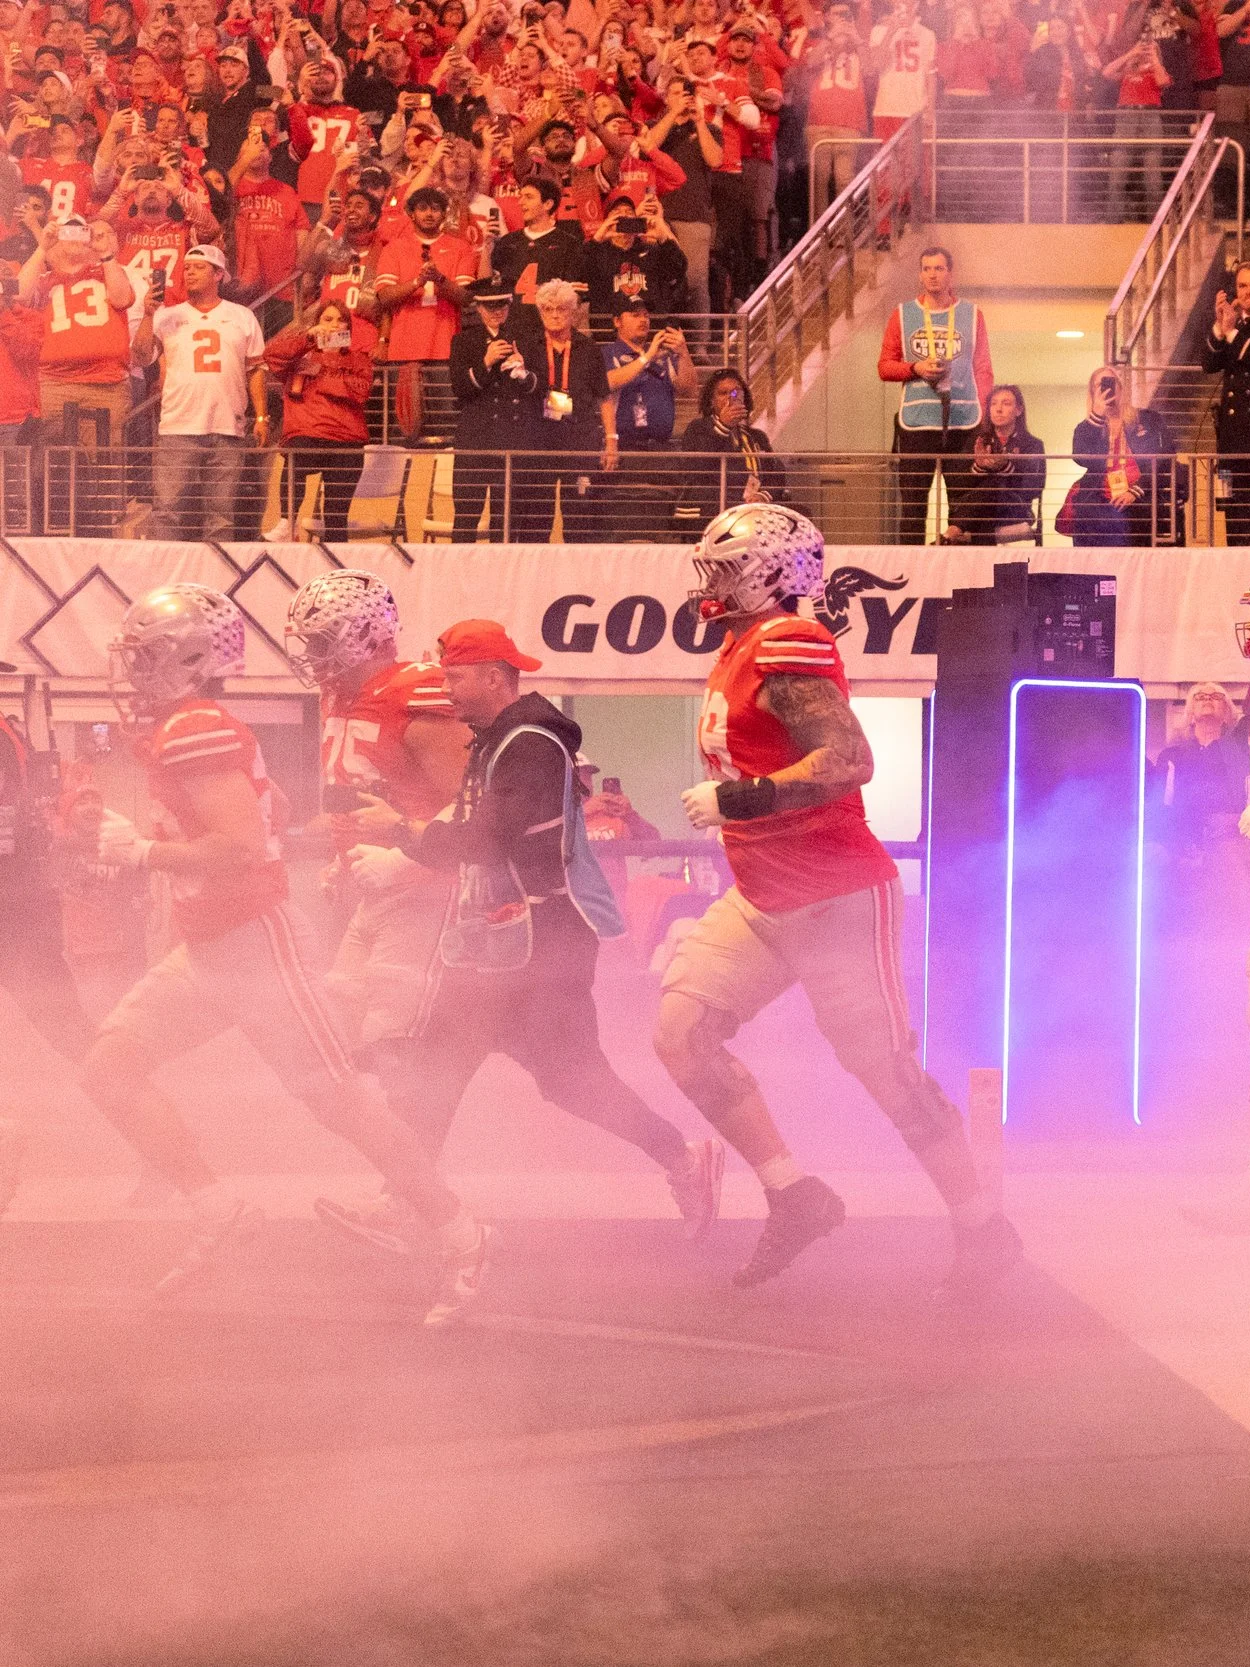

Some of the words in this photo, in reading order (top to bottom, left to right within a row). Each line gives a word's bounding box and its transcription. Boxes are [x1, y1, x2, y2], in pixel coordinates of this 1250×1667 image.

[895, 40, 919, 72] 15
[307, 115, 351, 153] 97
[149, 233, 182, 247] STATE
[124, 248, 179, 288] 47
[514, 263, 539, 304] 4
[51, 278, 109, 333] 13
[192, 329, 222, 373] 2
[322, 716, 381, 785] 75
